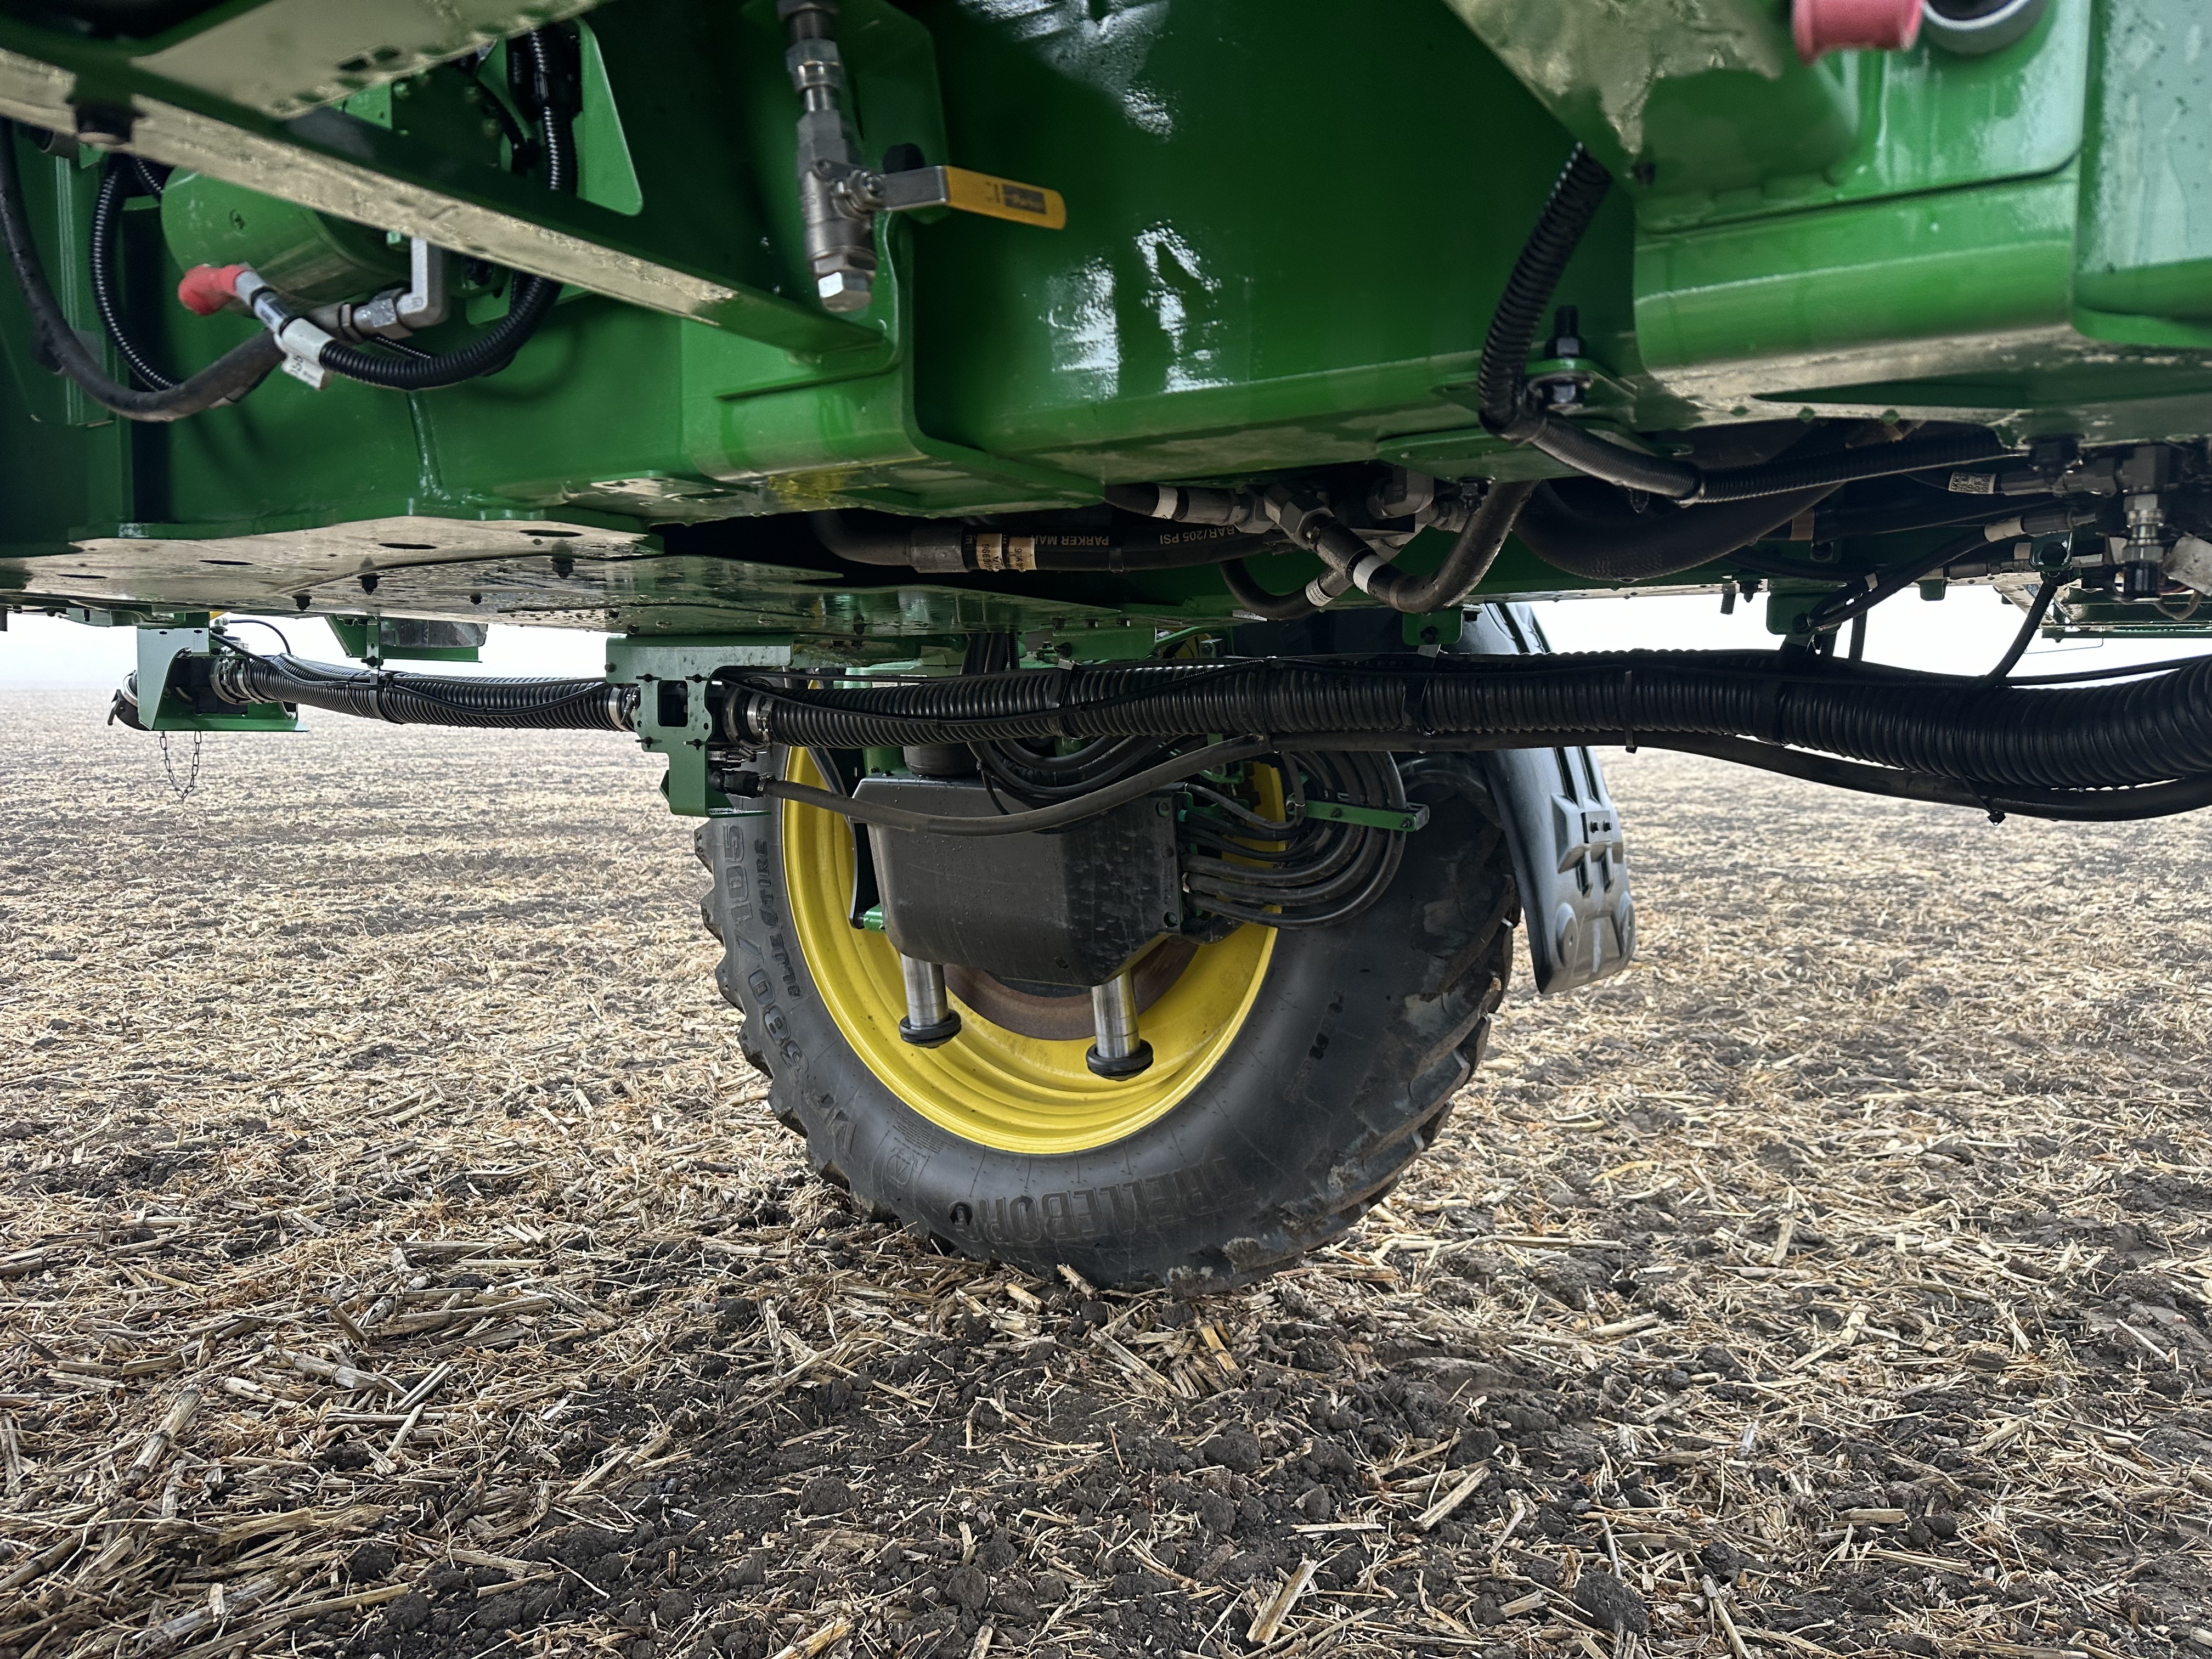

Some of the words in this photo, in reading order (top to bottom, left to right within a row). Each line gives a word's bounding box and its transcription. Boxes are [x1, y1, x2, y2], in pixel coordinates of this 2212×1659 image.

[1062, 535, 1109, 545] PARKER
[1160, 533, 1180, 545] PSI
[1183, 526, 1234, 541] BAR/205
[754, 839, 775, 902] TIRE
[723, 824, 809, 1076] 380/105
[769, 933, 802, 999] BLUE
[949, 1155, 1256, 1244] TRELLEBORG
